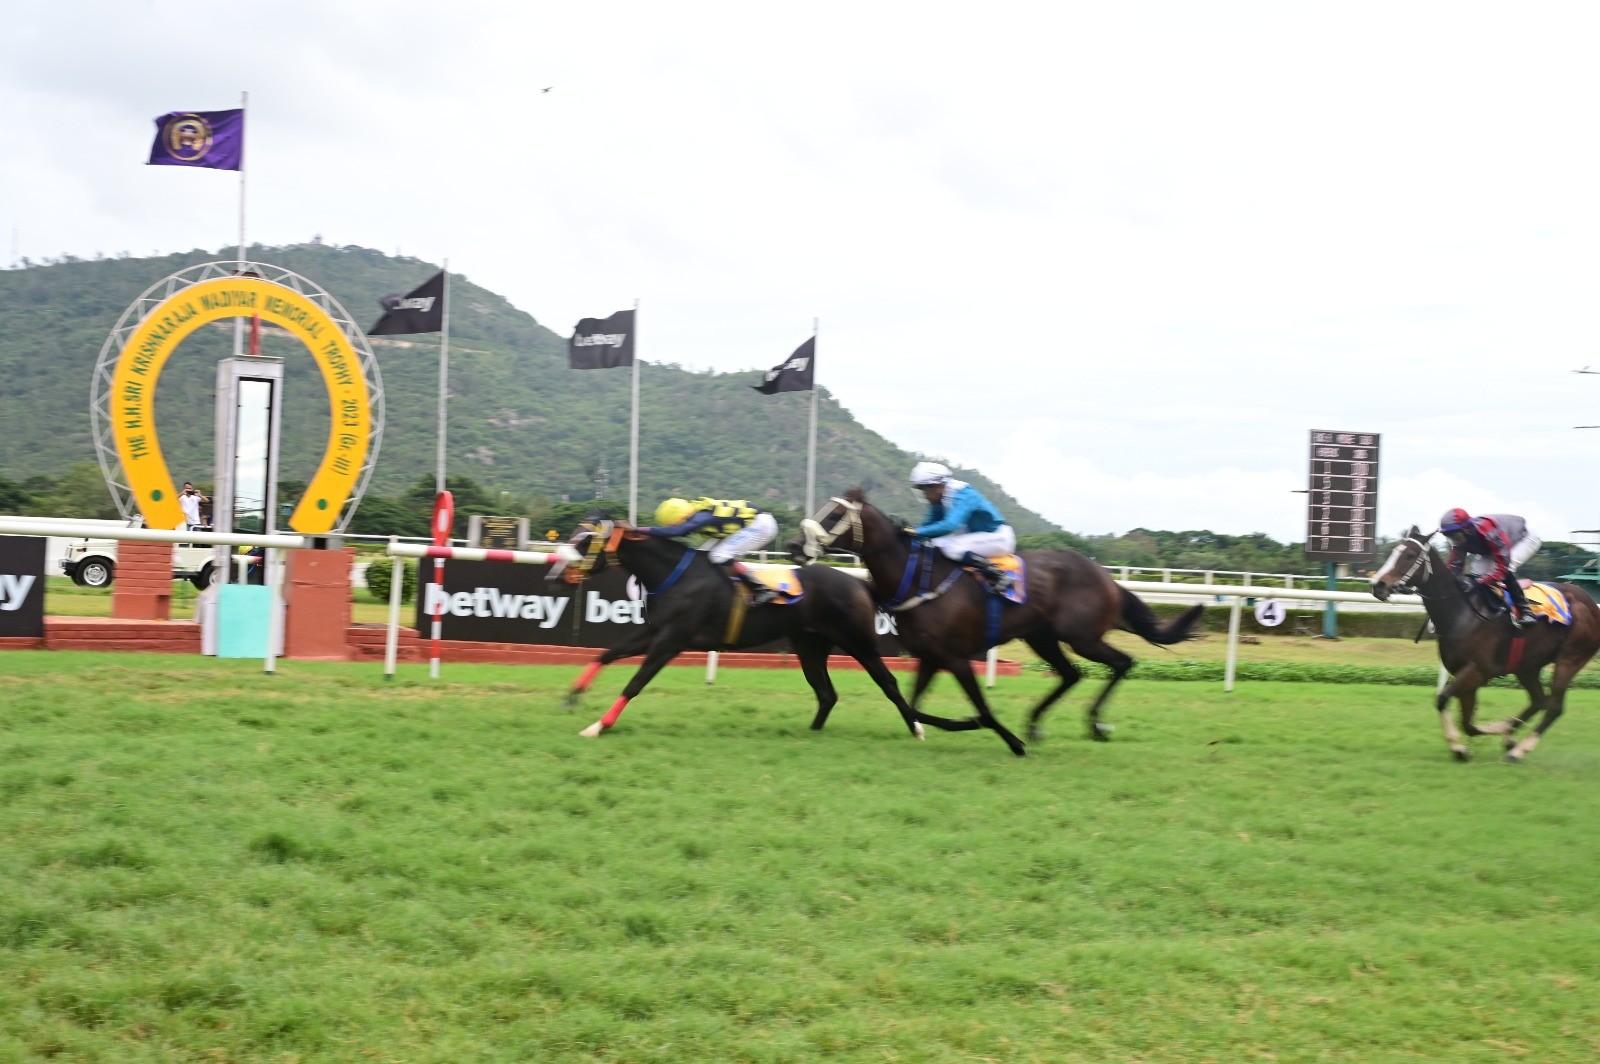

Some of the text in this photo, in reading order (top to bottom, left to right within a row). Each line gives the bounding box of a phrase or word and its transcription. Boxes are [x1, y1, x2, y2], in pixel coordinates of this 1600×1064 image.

[126, 435, 150, 460] THE
[265, 295, 326, 340] MEMORIAL
[321, 340, 355, 386] TROPHY
[341, 399, 359, 427] 2023
[0, 574, 38, 610] y
[424, 582, 570, 629] betway
[1262, 602, 1277, 624] 4
